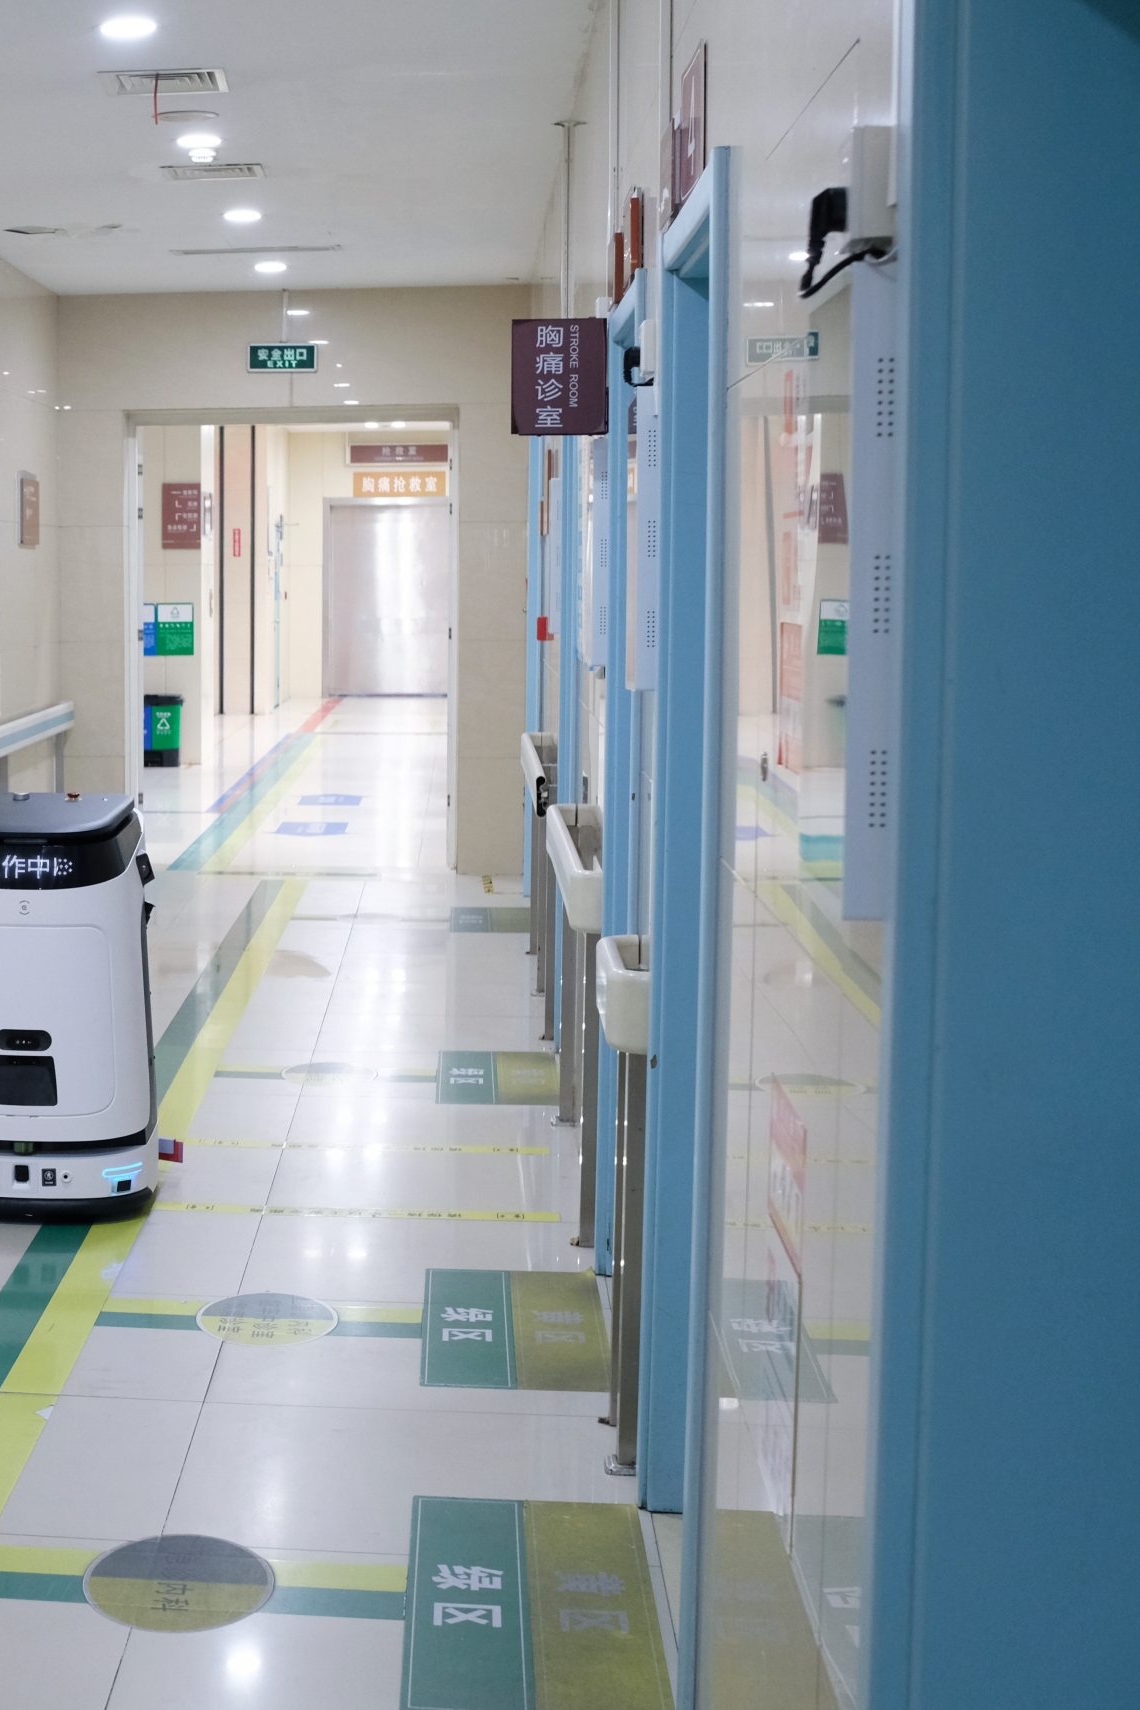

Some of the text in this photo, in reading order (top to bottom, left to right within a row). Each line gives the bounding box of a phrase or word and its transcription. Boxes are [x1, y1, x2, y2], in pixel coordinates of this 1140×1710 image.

[257, 348, 307, 360] 安全出口
[267, 360, 298, 368] EXIT
[569, 324, 579, 407] STROKE ROOM
[535, 325, 564, 427] 胸痛诊室
[362, 475, 437, 493] 胸痛抢救室
[449, 1068, 484, 1084] 绿区
[441, 1307, 493, 1342] 绿区
[531, 1310, 586, 1344] 黄区
[432, 1564, 503, 1628] 绿区
[554, 1570, 630, 1633] 黄区
